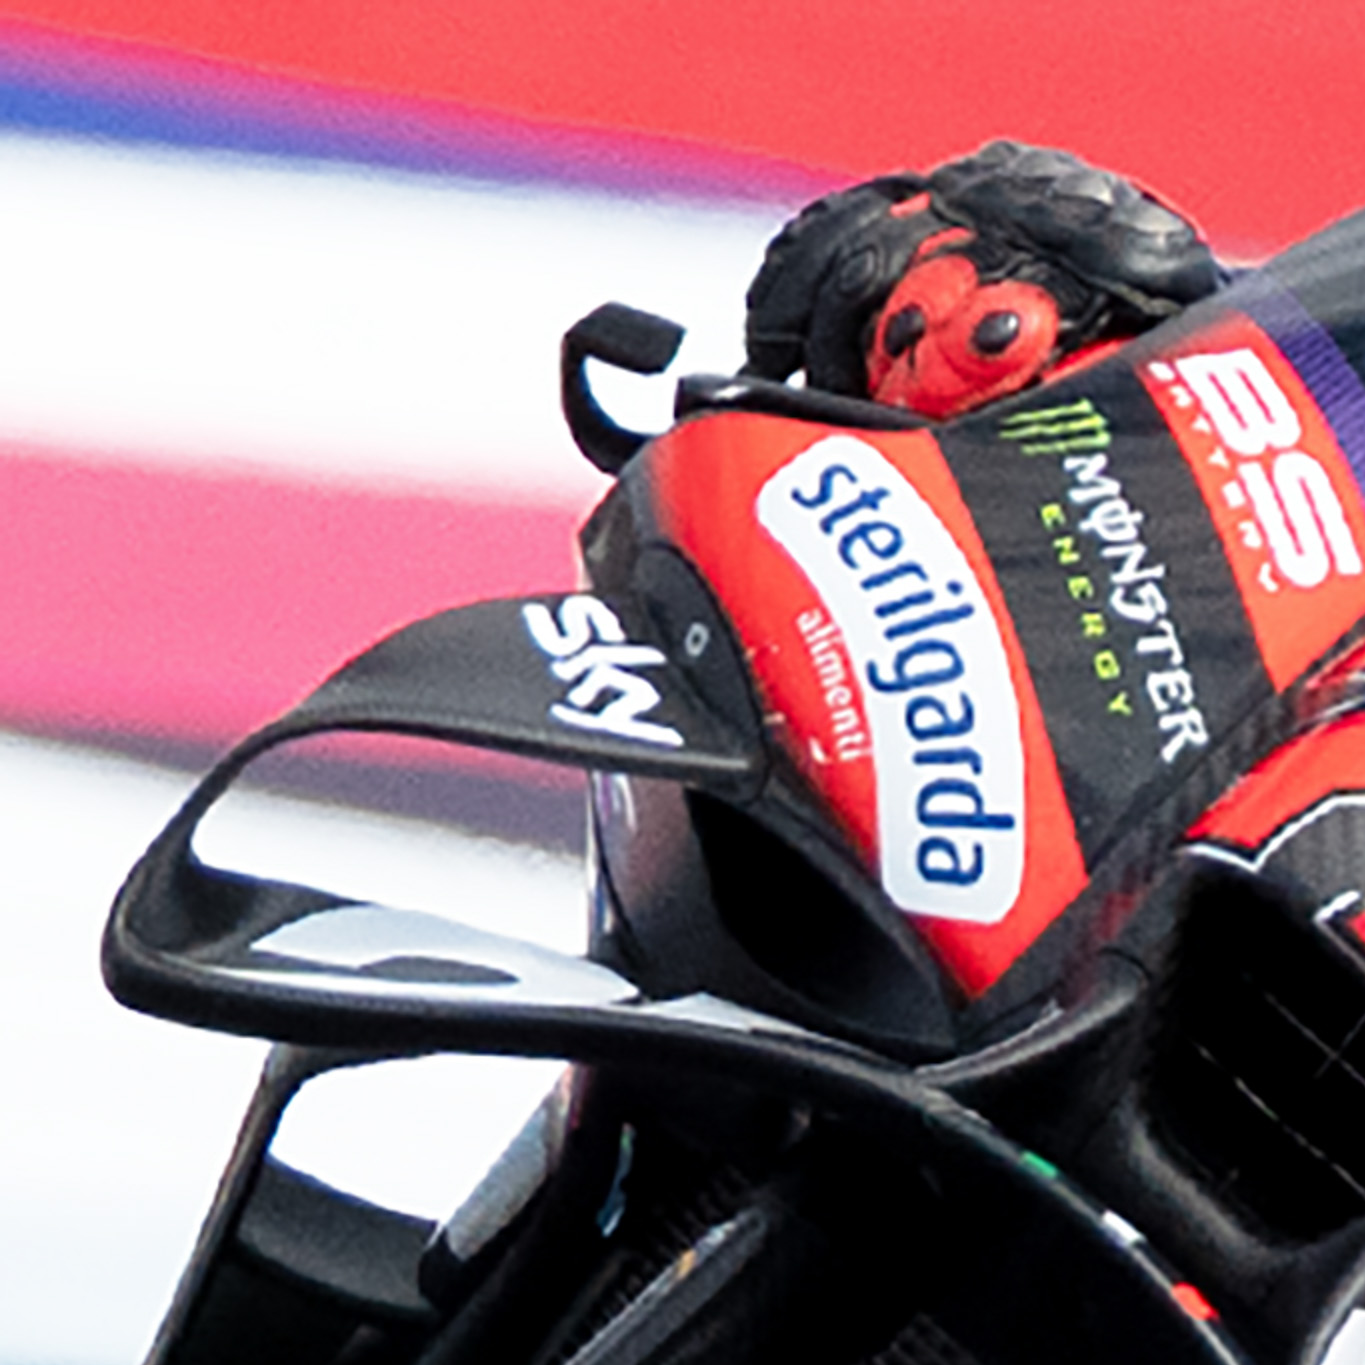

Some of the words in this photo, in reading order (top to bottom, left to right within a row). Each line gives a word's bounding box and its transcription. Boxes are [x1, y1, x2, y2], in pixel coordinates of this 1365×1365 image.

[1173, 347, 1364, 588] BS
[521, 594, 685, 748] sky
[791, 463, 1016, 887] sterilgarda
[796, 608, 872, 763] alimenti
[1041, 504, 1132, 716] ENERGY
[1063, 454, 1210, 763] MONSTER
